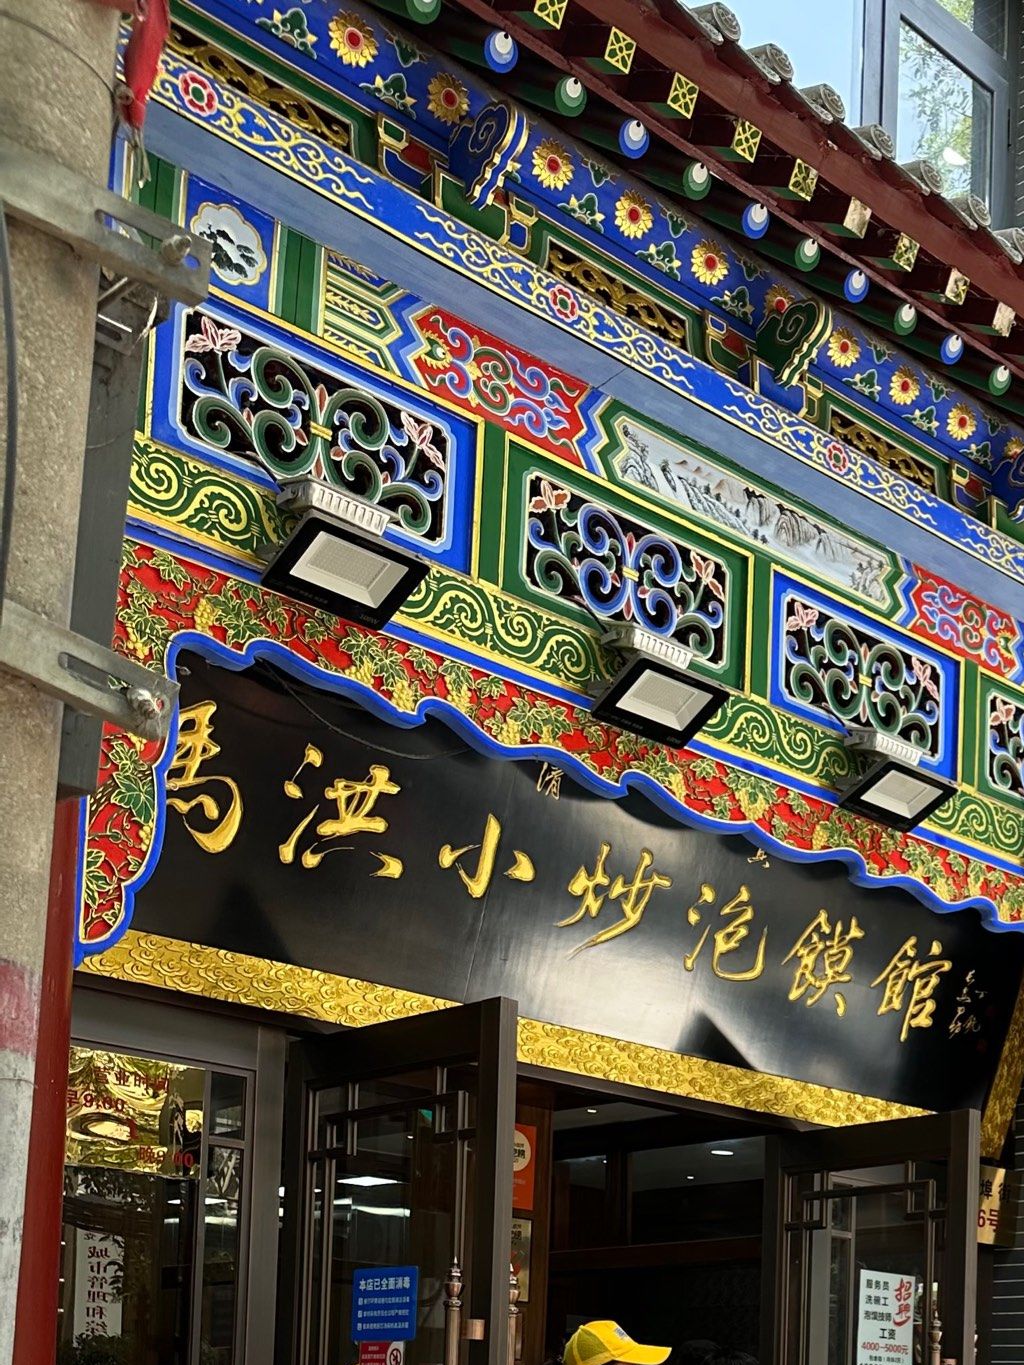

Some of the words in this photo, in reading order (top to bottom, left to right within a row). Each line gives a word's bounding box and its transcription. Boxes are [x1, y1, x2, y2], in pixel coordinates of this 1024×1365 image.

[359, 1276, 411, 1291] 本店已全面消毒
[866, 1279, 890, 1291] 服务员
[879, 1328, 896, 1341] 工资
